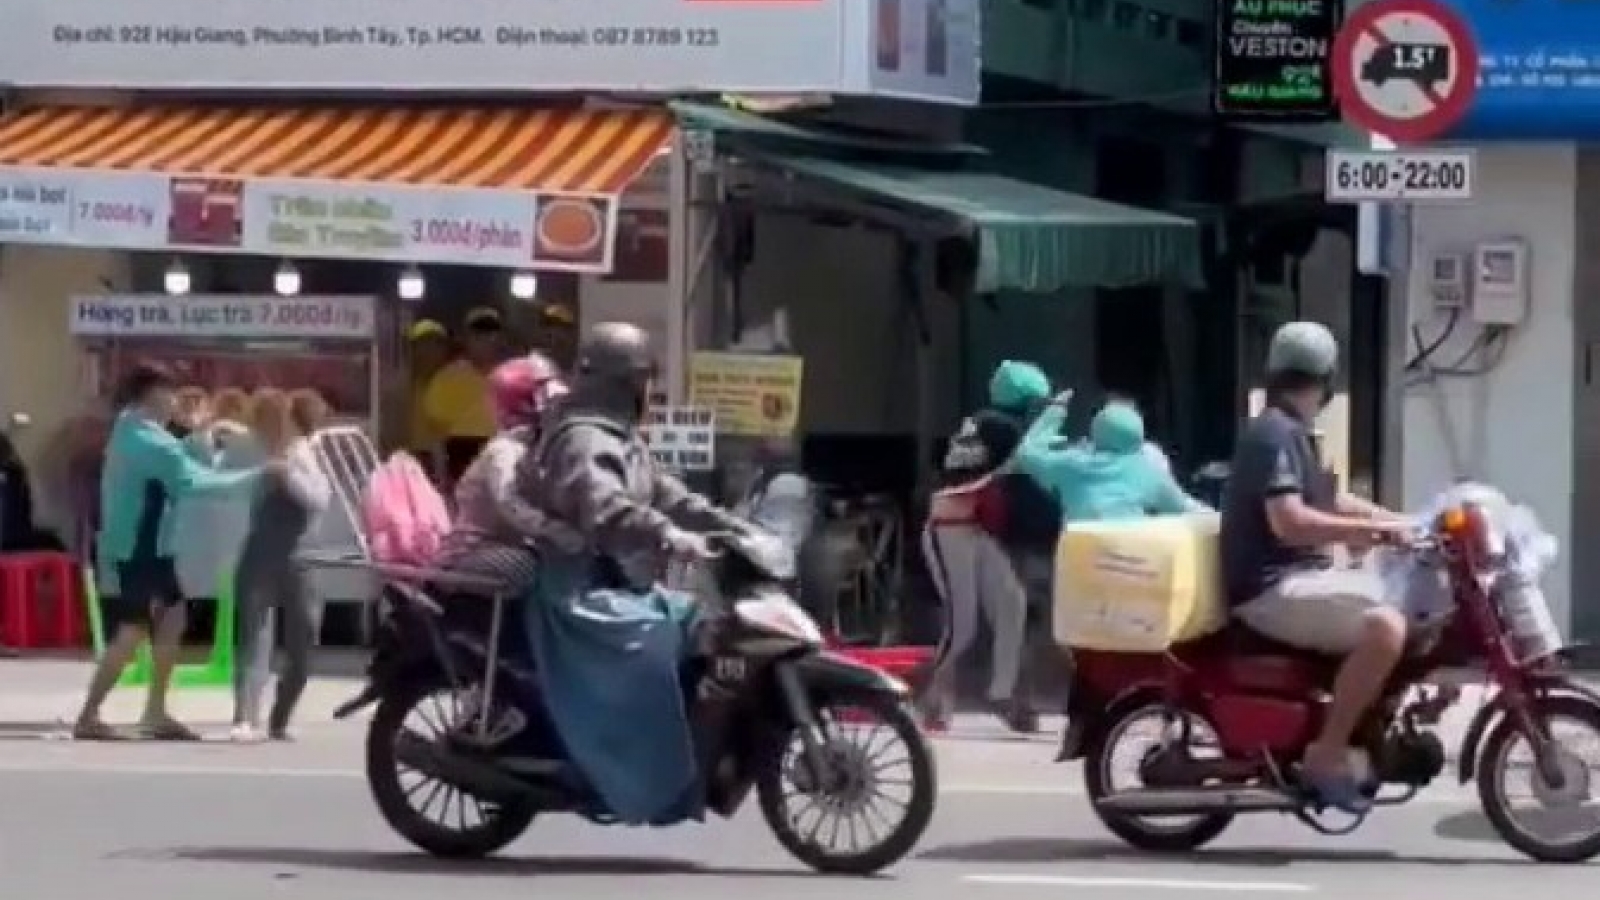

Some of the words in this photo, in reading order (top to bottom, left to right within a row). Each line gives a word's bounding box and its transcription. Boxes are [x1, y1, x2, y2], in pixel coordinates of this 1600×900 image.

[54, 26, 82, 46] Địa
[155, 27, 192, 45] Hậu
[1229, 37, 1327, 58] VESTON
